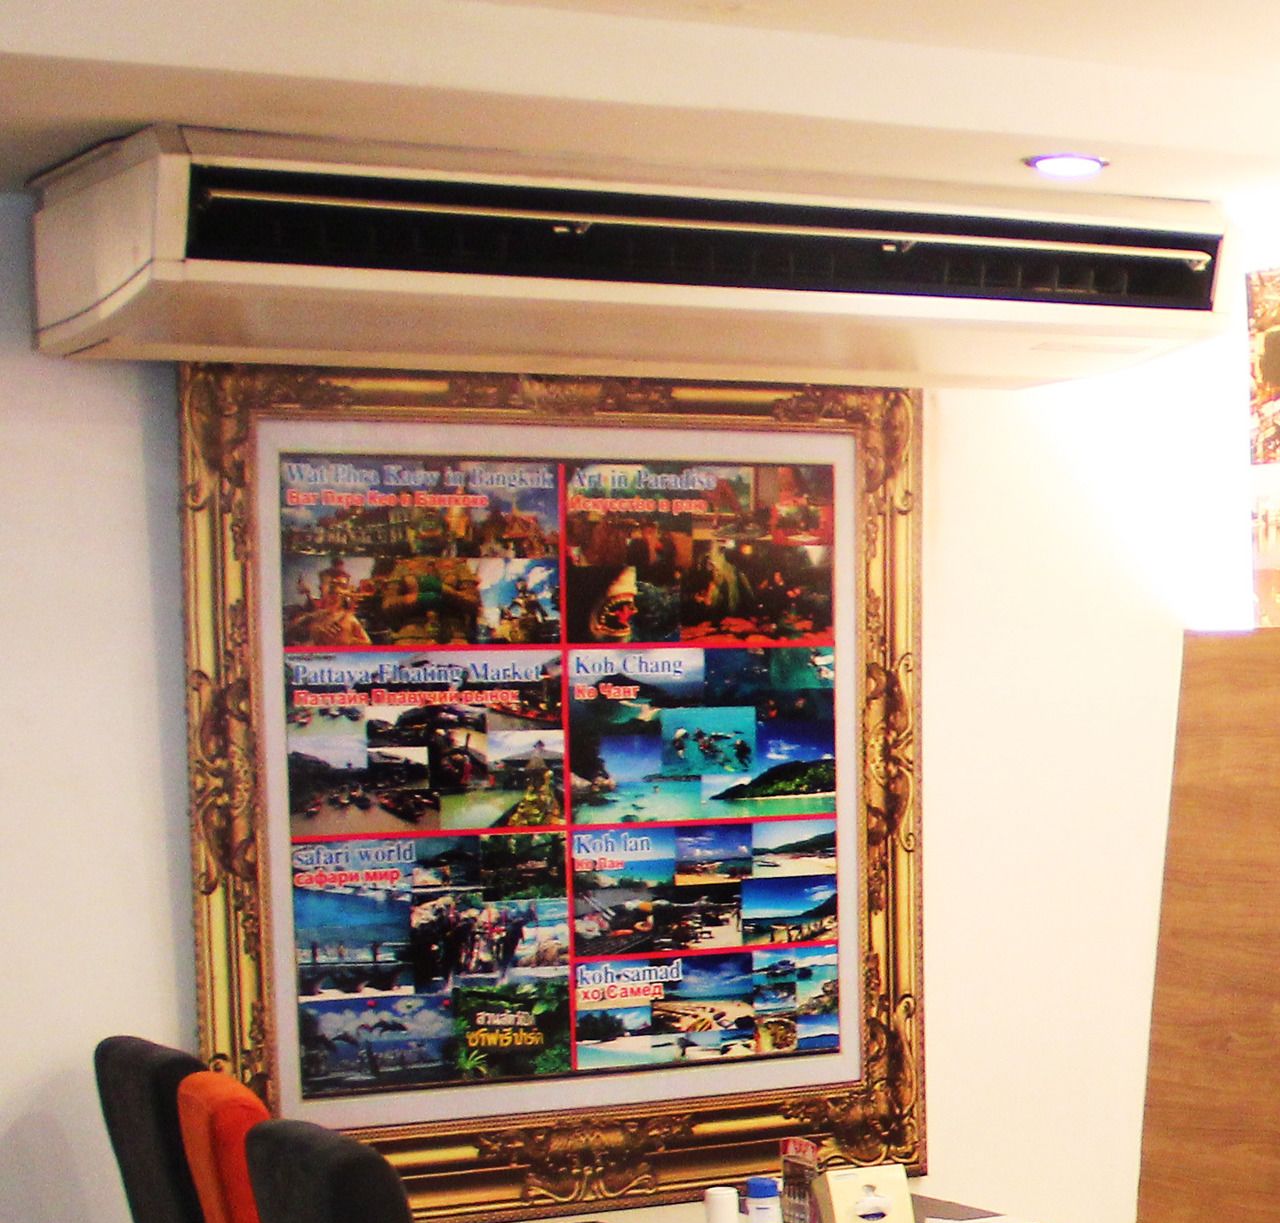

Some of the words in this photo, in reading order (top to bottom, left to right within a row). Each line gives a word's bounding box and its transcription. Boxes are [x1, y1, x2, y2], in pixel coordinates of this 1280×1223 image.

[470, 466, 554, 489] Bangkok
[635, 468, 717, 490] Paradise
[294, 663, 373, 687] Pattaya
[378, 663, 463, 687] Floating
[468, 661, 542, 682] Market
[575, 656, 615, 674] Koh
[622, 655, 683, 676] Chang
[599, 683, 640, 699] Чанг
[358, 839, 416, 865] world
[574, 834, 617, 855] Koh
[293, 868, 361, 888] сафари
[363, 867, 400, 886] мир
[577, 964, 614, 986] koh
[620, 959, 683, 983] samad
[605, 982, 665, 1000] Самед
